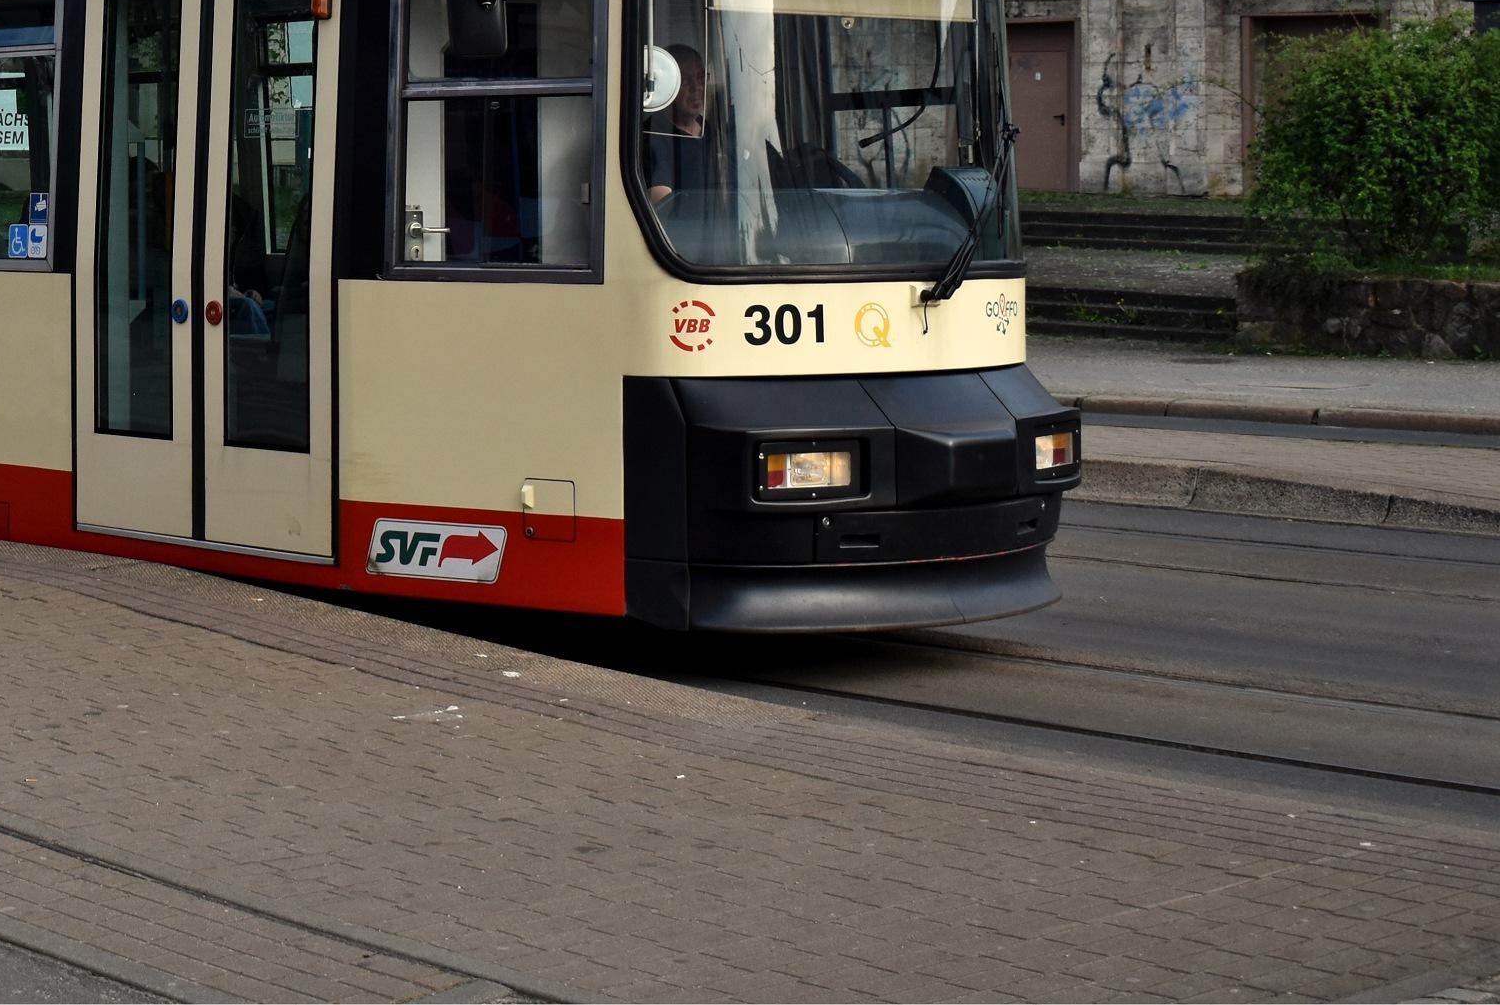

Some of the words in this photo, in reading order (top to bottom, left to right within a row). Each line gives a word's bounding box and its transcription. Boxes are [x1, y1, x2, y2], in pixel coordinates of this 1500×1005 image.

[674, 319, 711, 333] VBB
[744, 304, 825, 346] 301
[375, 530, 441, 567] SVF
